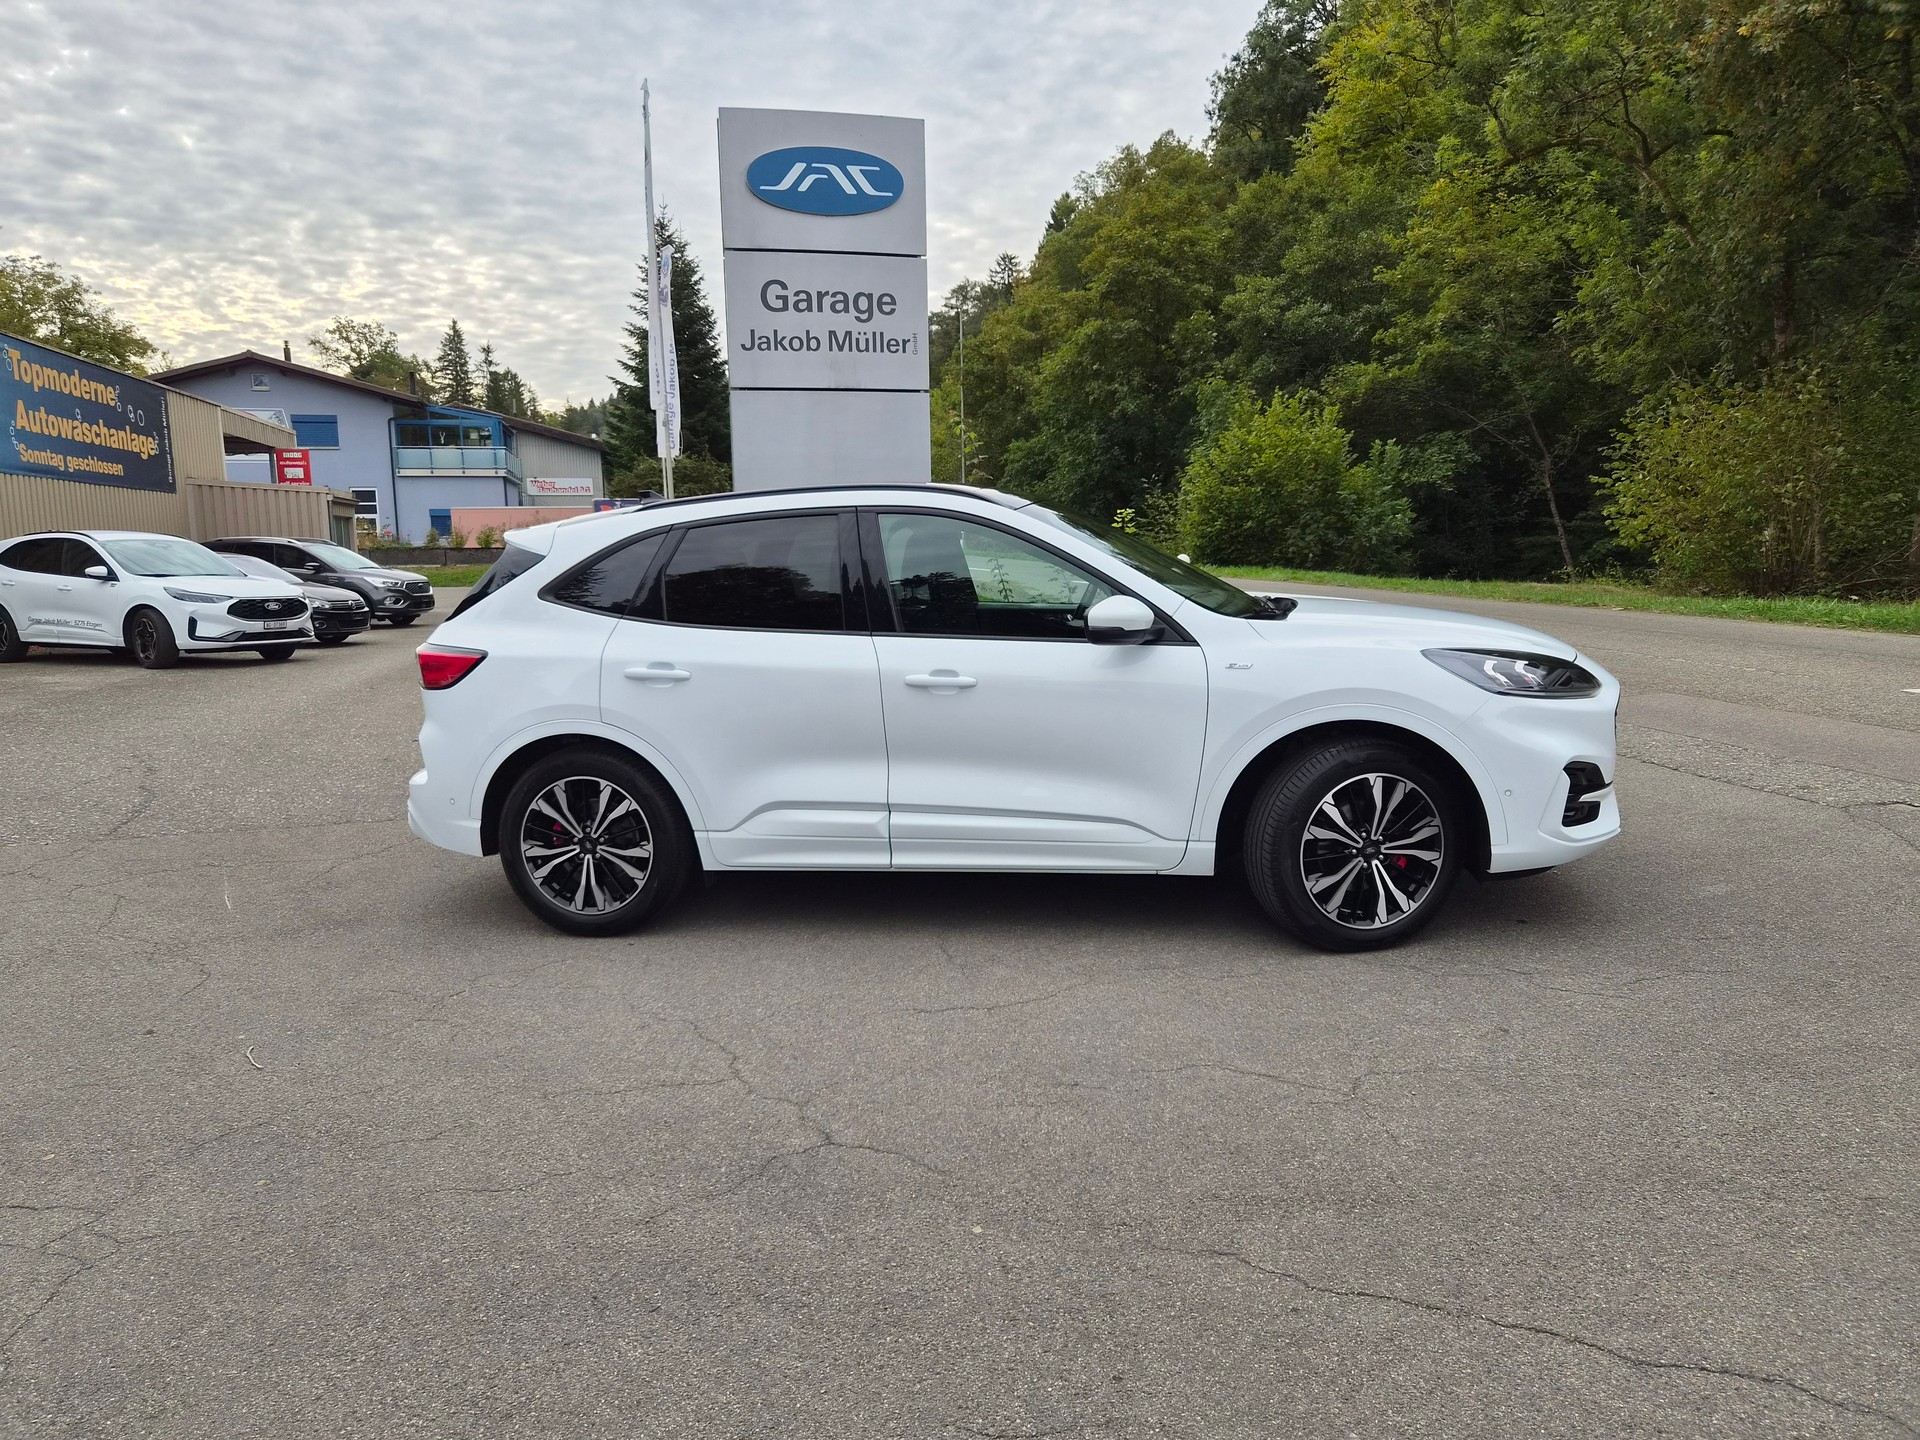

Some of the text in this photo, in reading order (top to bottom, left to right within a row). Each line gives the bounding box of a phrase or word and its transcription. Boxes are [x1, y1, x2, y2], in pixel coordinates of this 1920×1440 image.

[760, 162, 893, 196] JAC
[760, 279, 897, 323] Garage
[740, 329, 821, 352] Jakob
[828, 330, 911, 354] Müller
[8, 348, 117, 407] Topmoderne
[16, 399, 157, 461] Autowaschanlage
[19, 443, 124, 477] Sonntag geschlossen
